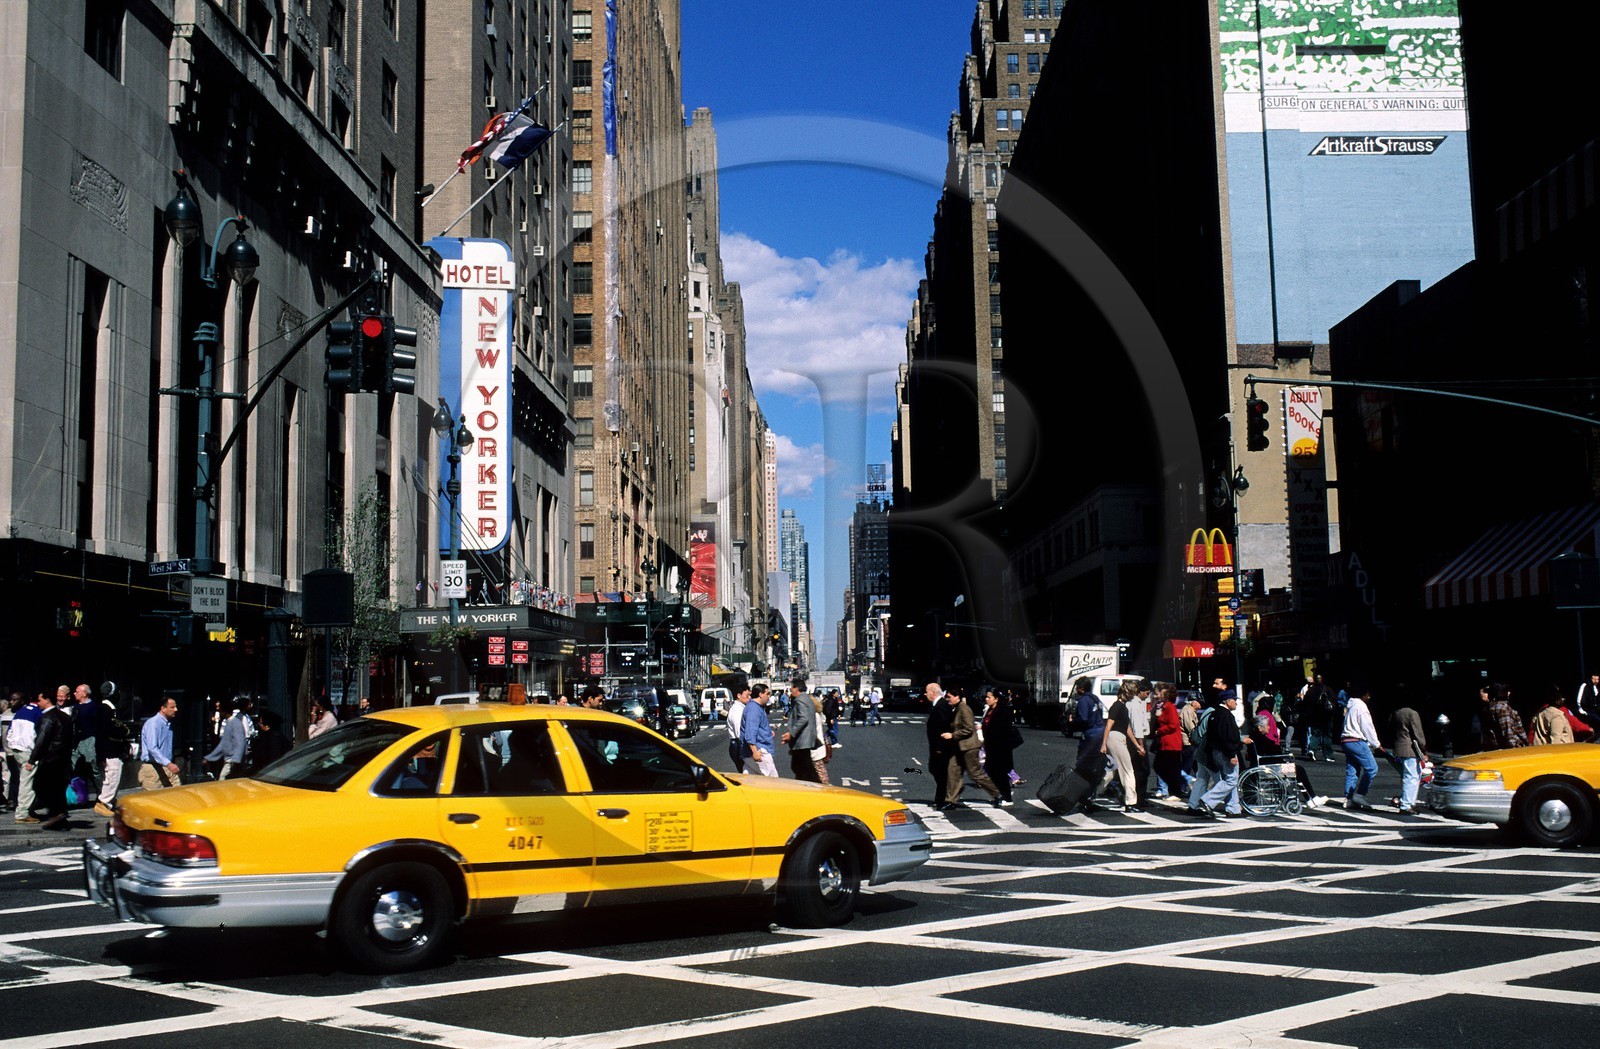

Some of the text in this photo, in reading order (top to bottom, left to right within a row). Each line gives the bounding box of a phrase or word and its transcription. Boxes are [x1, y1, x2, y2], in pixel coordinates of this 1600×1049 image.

[1320, 99, 1379, 110] GENERAL'S
[1381, 99, 1439, 109] WARNING:
[446, 264, 511, 285] HOTEL
[475, 296, 501, 369] NEW
[1289, 391, 1318, 404] ADULT
[1288, 406, 1321, 439] BOOKS
[476, 385, 500, 538] YORKER
[1294, 503, 1325, 513] OPEN
[1300, 515, 1319, 526] 24
[1294, 528, 1327, 539] HOURS
[150, 564, 165, 574] West
[177, 560, 186, 571] St
[1186, 565, 1234, 574] McDonald's
[444, 575, 463, 587] 30
[193, 586, 225, 596] DON'T BLOCK
[199, 597, 220, 606] THE BOX
[416, 613, 518, 625] THE NW YORKER
